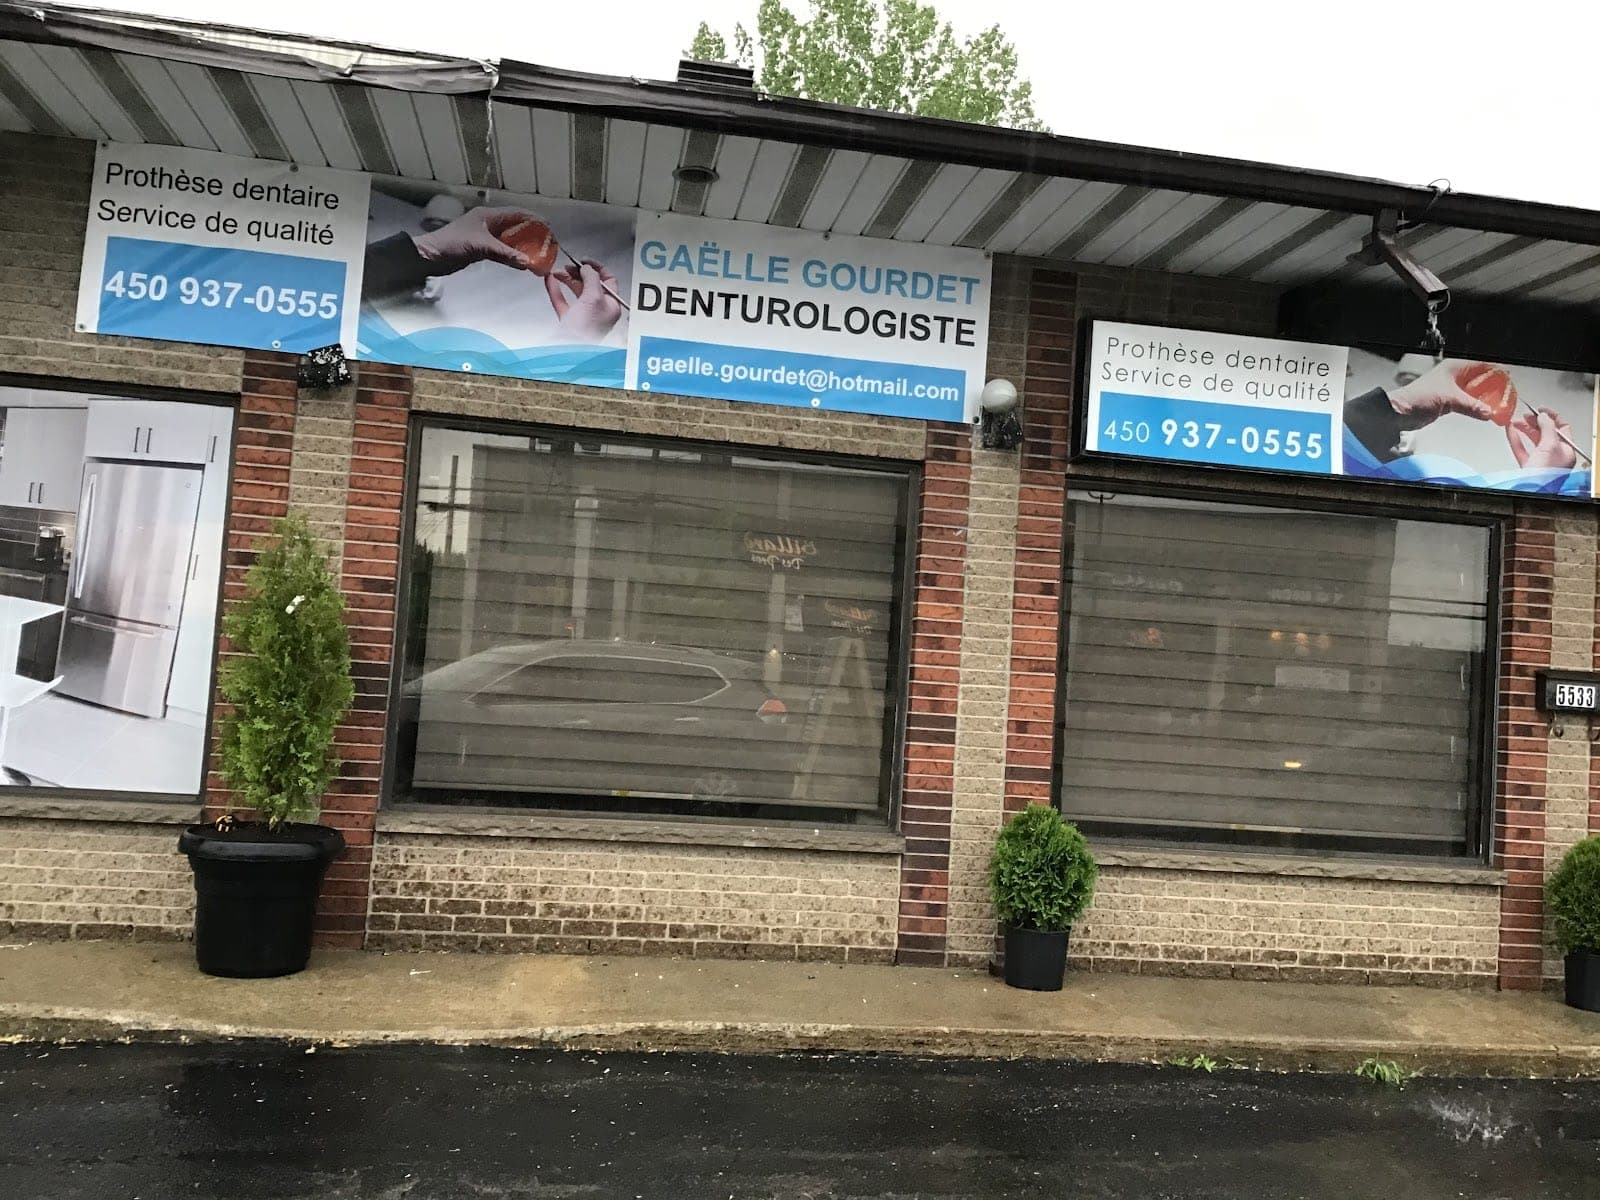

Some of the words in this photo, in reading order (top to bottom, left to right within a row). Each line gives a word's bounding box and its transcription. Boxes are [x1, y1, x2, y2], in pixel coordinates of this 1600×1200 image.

[105, 162, 223, 196] Prothèse
[232, 178, 339, 210] dentaire
[97, 199, 196, 230] Service
[205, 211, 238, 235] de
[247, 219, 334, 245] qualité
[104, 270, 168, 301] 450
[179, 276, 338, 320] 937-0555
[640, 240, 790, 285] GAËLLE
[802, 259, 980, 305] GOURDET
[637, 282, 976, 347] DENTUROLOGISTE
[646, 355, 959, 401] gaelle.gourdet@hotmail.com
[1107, 336, 1214, 367] Prothèse
[1225, 350, 1330, 377] dentaire
[1101, 361, 1192, 389] Service
[1203, 373, 1233, 393] de
[1245, 380, 1331, 402] qualité
[1104, 420, 1150, 443] 450
[1161, 418, 1323, 459] 937-0555
[1558, 685, 1593, 706] 5533
